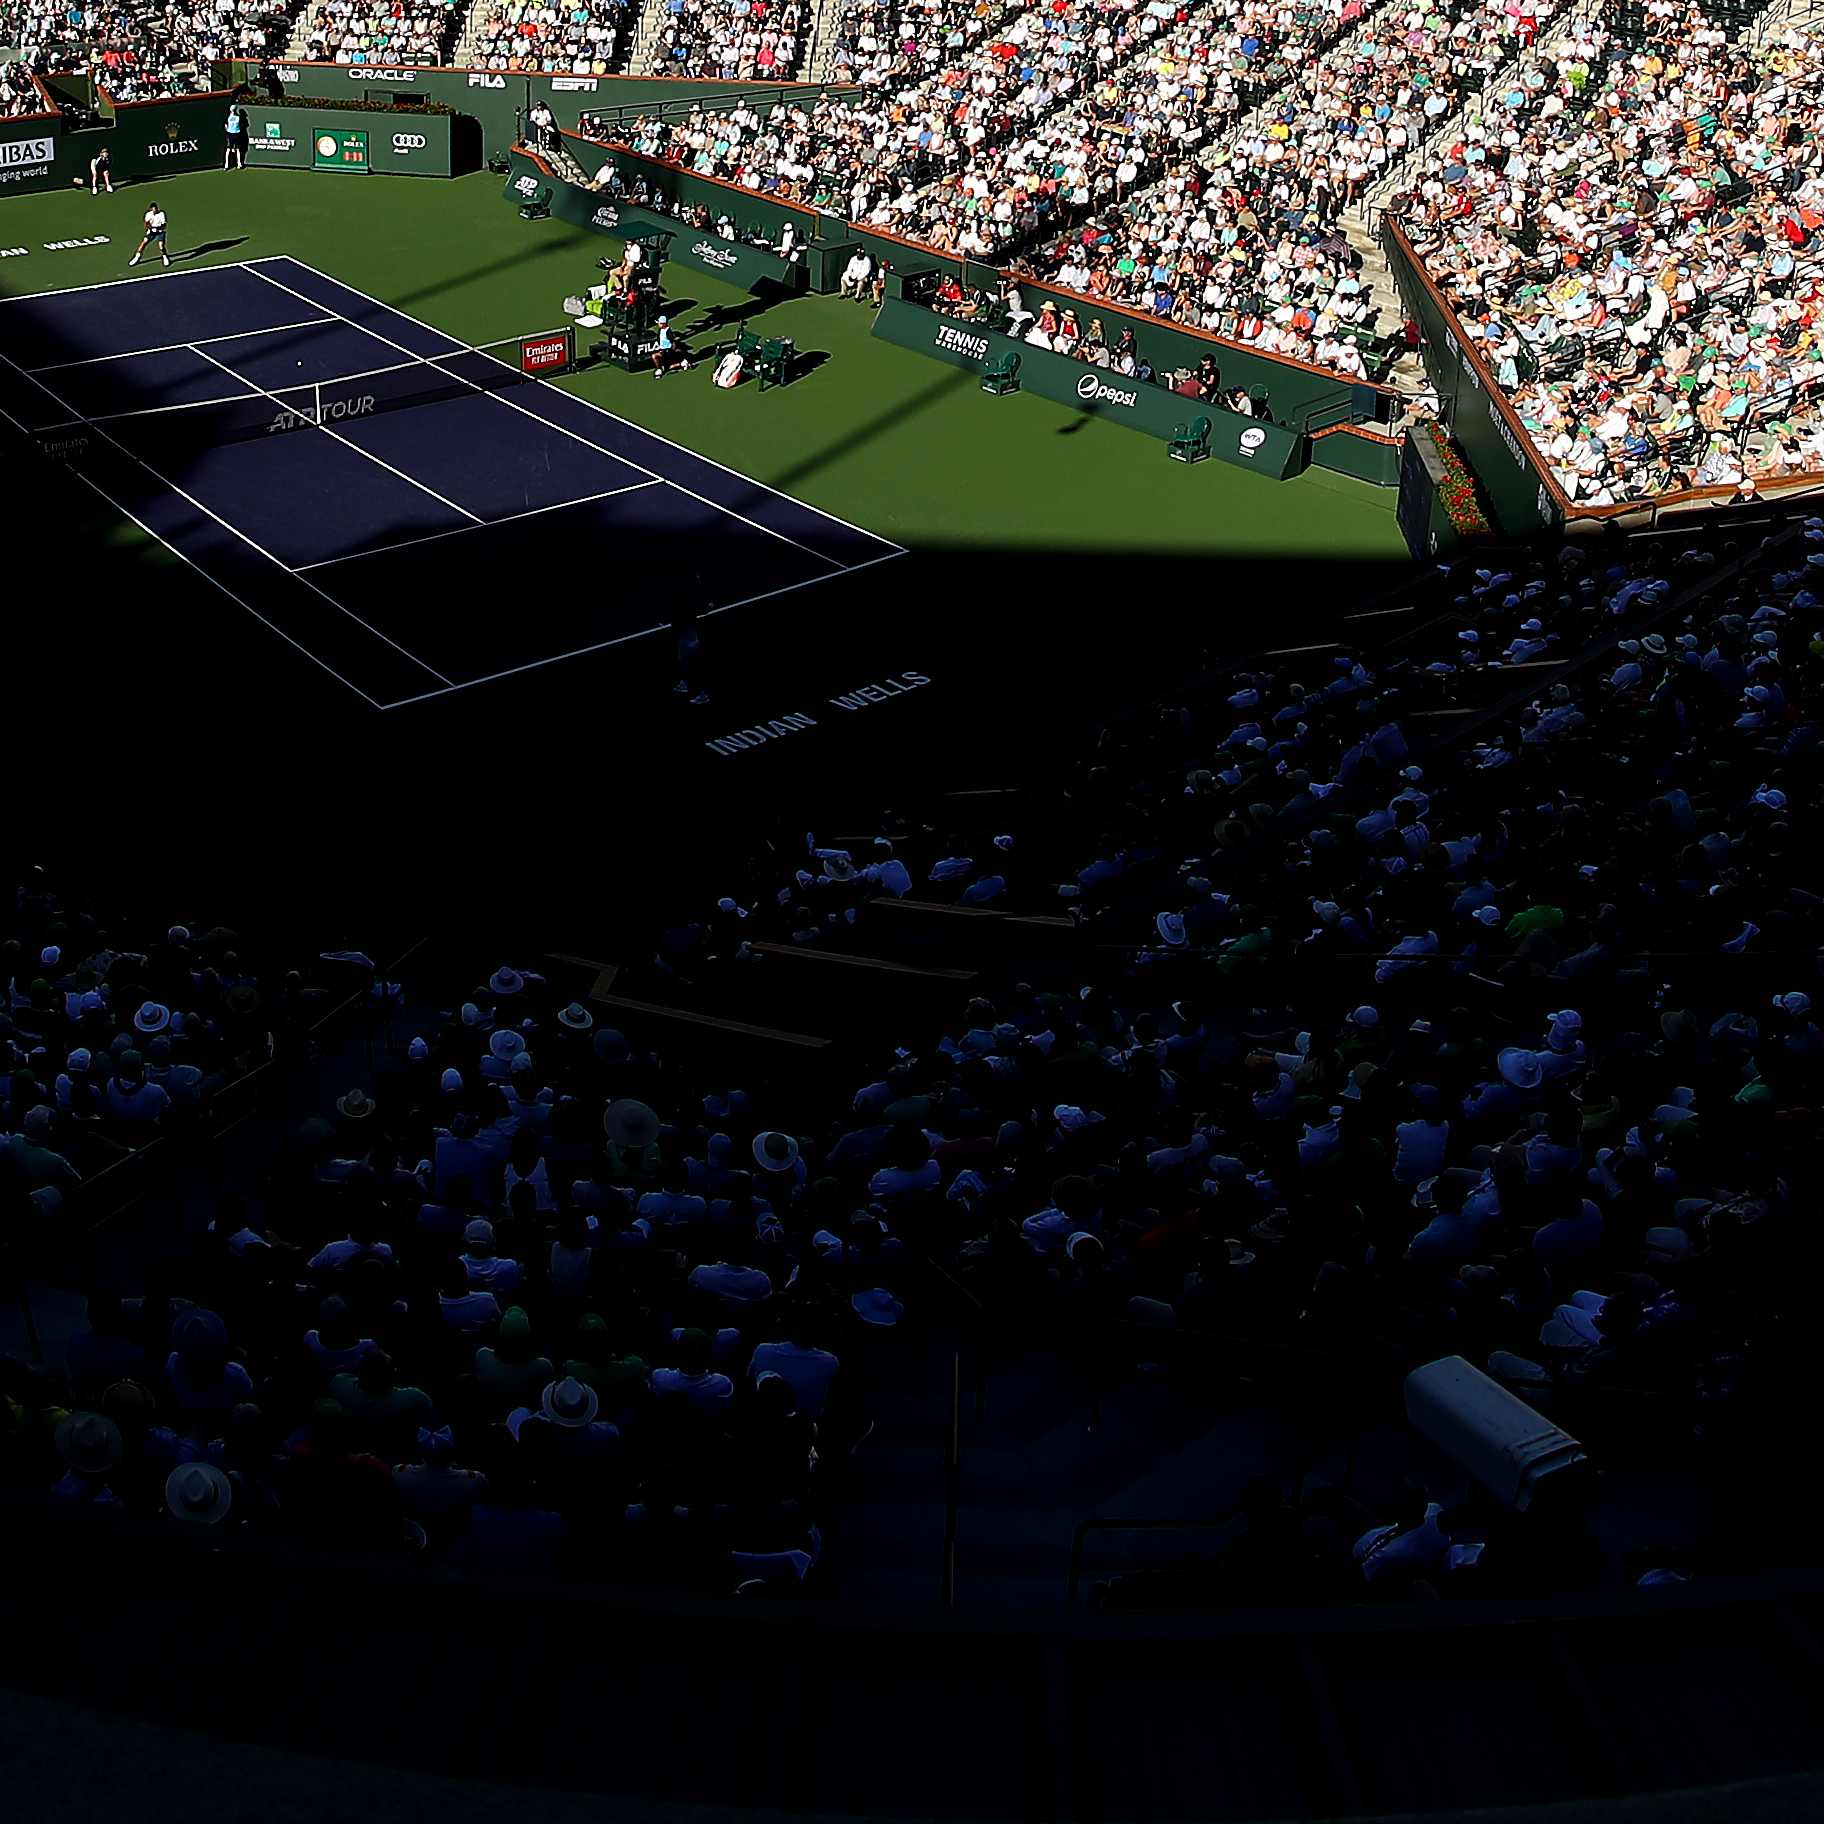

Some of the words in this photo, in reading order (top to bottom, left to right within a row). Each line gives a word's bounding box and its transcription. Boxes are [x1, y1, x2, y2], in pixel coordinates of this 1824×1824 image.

[348, 69, 417, 81] ORACLE
[468, 73, 506, 89] FILA
[551, 77, 598, 92] ESPN
[147, 139, 199, 157] ROLEX
[22, 166, 48, 178] world
[43, 235, 111, 251] WELLS
[938, 325, 989, 354] TENNIS
[526, 342, 564, 358] Emirates
[935, 338, 984, 361] WAREHOUSE
[1095, 383, 1137, 407] pepsi
[321, 395, 375, 421] TOUR
[705, 712, 818, 756] INDIAN
[828, 671, 932, 711] WELLS
